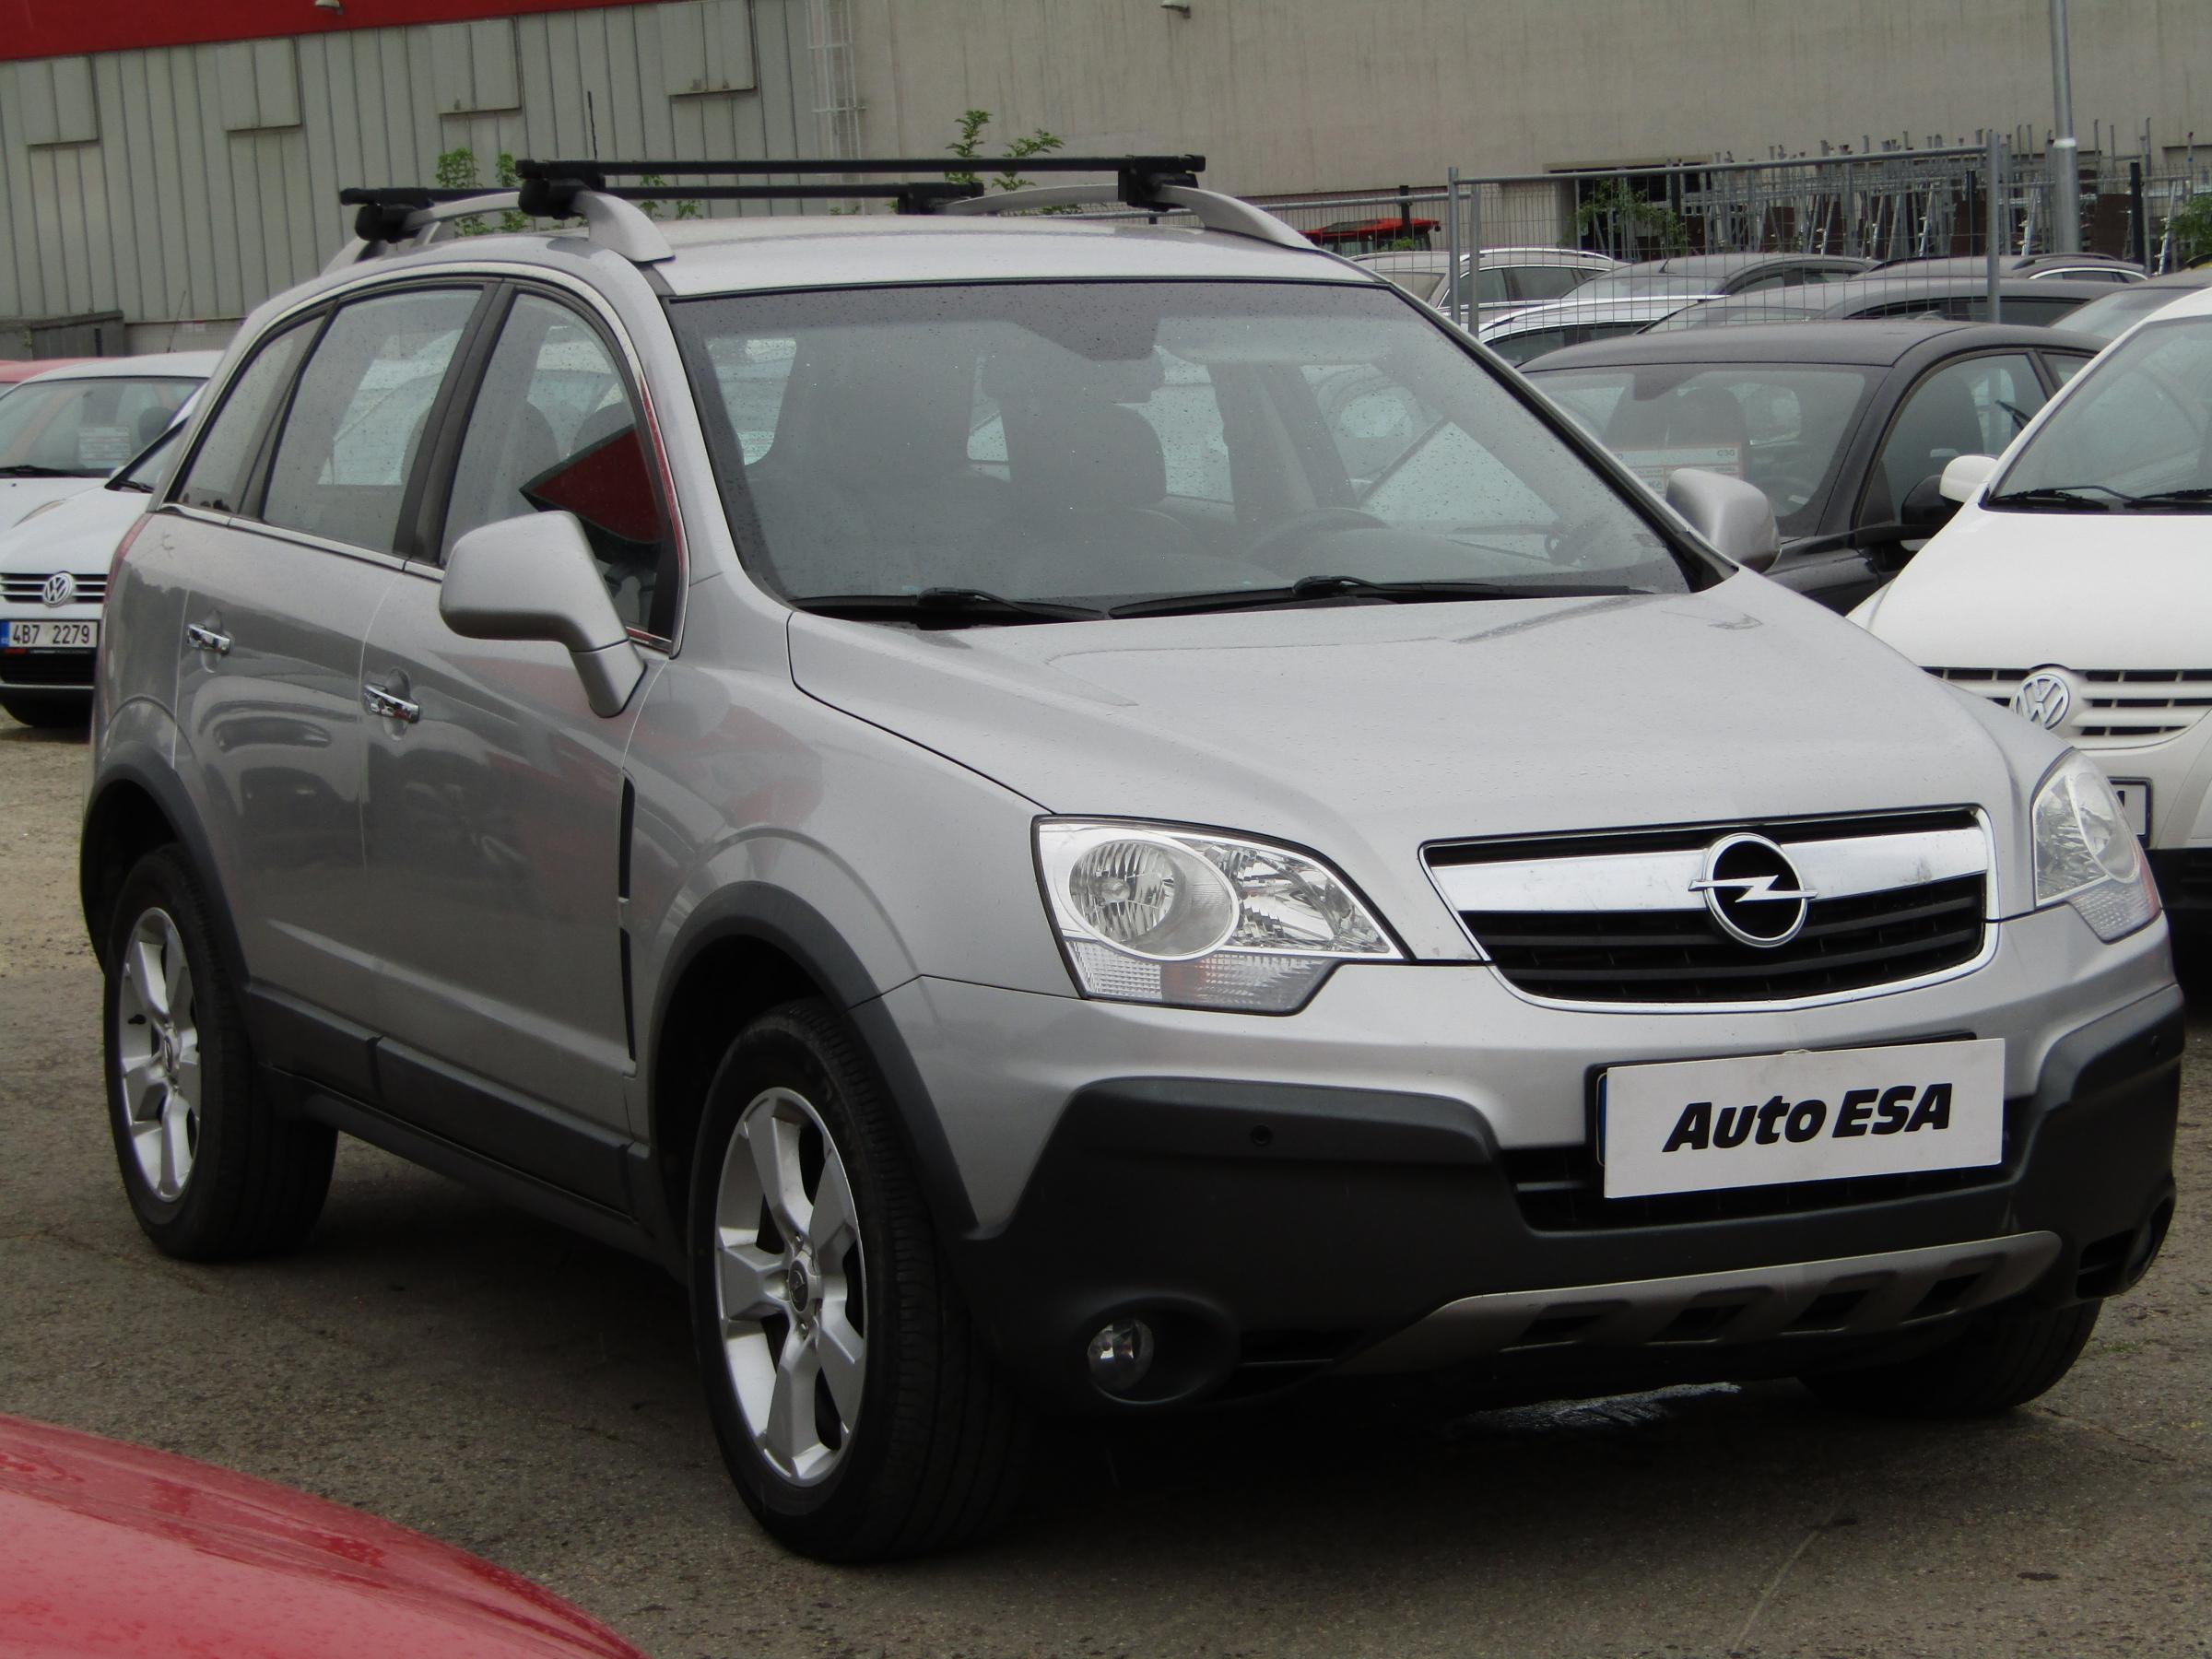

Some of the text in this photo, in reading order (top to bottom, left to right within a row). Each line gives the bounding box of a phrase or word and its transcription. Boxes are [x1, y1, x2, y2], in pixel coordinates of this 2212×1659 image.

[12, 624, 90, 644] 4B7 2279
[1661, 1083, 1953, 1153] Auto ESA
